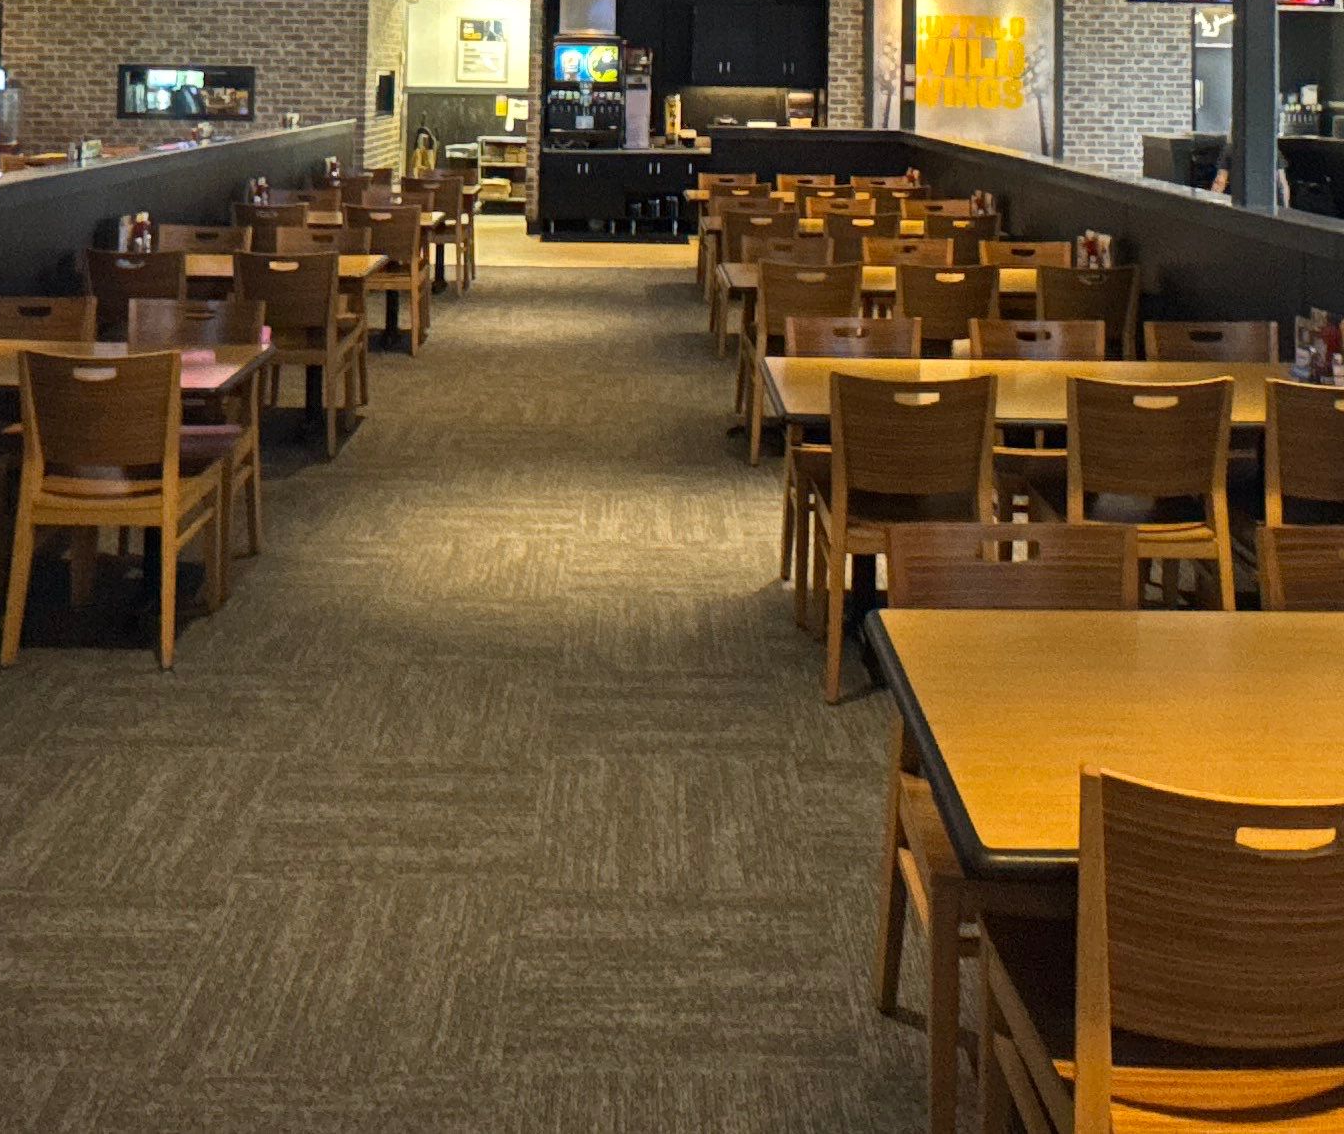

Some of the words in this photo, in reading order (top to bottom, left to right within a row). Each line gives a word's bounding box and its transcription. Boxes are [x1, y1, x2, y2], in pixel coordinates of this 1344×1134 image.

[917, 15, 1026, 39] UFFALO
[916, 37, 1025, 77] WILD
[916, 76, 1025, 111] WINGS
